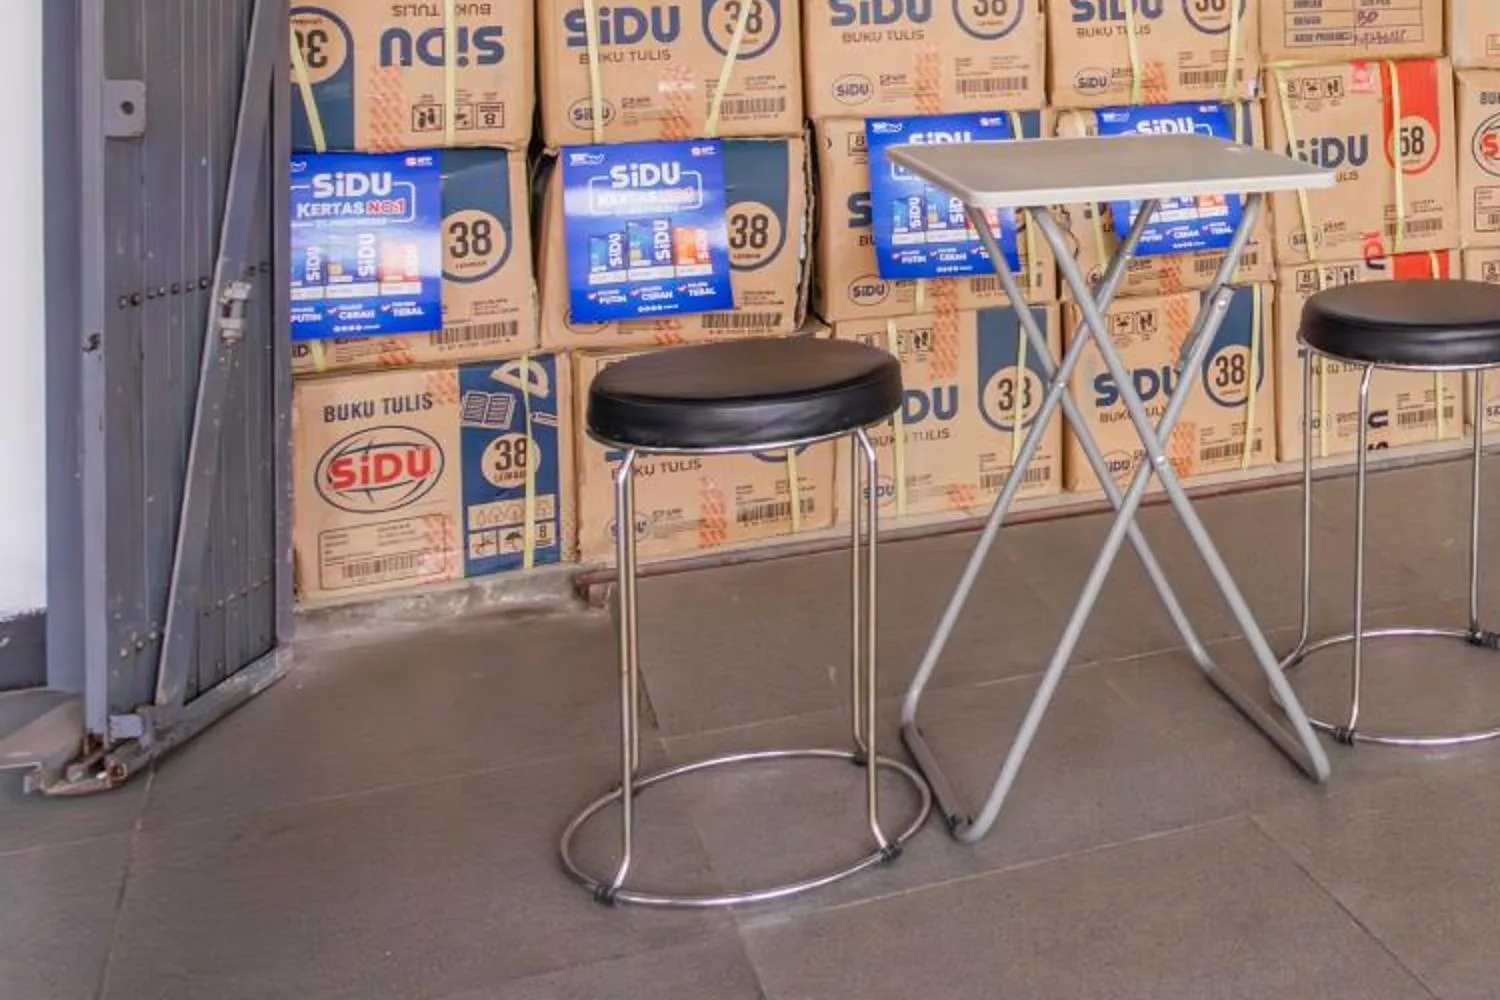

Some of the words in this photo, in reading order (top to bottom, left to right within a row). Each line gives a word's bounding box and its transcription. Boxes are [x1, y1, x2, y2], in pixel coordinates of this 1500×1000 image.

[391, 4, 440, 17] TULIS
[723, 0, 763, 35] 38
[564, 5, 681, 47] SiDU
[842, 31, 883, 43] BUKU
[887, 29, 925, 41] TULIS
[1076, 26, 1113, 38] BUKU
[380, 26, 505, 67] SiDU
[579, 51, 624, 65] BKU
[629, 48, 671, 62] TULIS
[836, 83, 869, 96] SiDU
[1136, 116, 1195, 136] SiDU
[1397, 126, 1425, 157] 58
[312, 171, 393, 198] SiDU
[609, 161, 681, 189] SiDU
[1335, 171, 1359, 183] ULIS
[296, 201, 364, 218] KERTAS
[949, 197, 965, 224] SiD
[449, 219, 493, 259] 38
[652, 219, 671, 261] SiDU
[730, 213, 769, 249] 38
[357, 233, 377, 277] SiDU
[852, 284, 885, 299] SiDU
[1215, 353, 1245, 387] 38
[1094, 365, 1180, 408] SDU
[324, 400, 375, 423] BUKU
[383, 393, 433, 416] TULIS
[903, 385, 958, 425] DU
[912, 427, 950, 442] TULIS
[328, 446, 434, 490] SiDU
[494, 438, 529, 472] 38
[660, 458, 702, 474] TULIS
[864, 485, 894, 499] SDU
